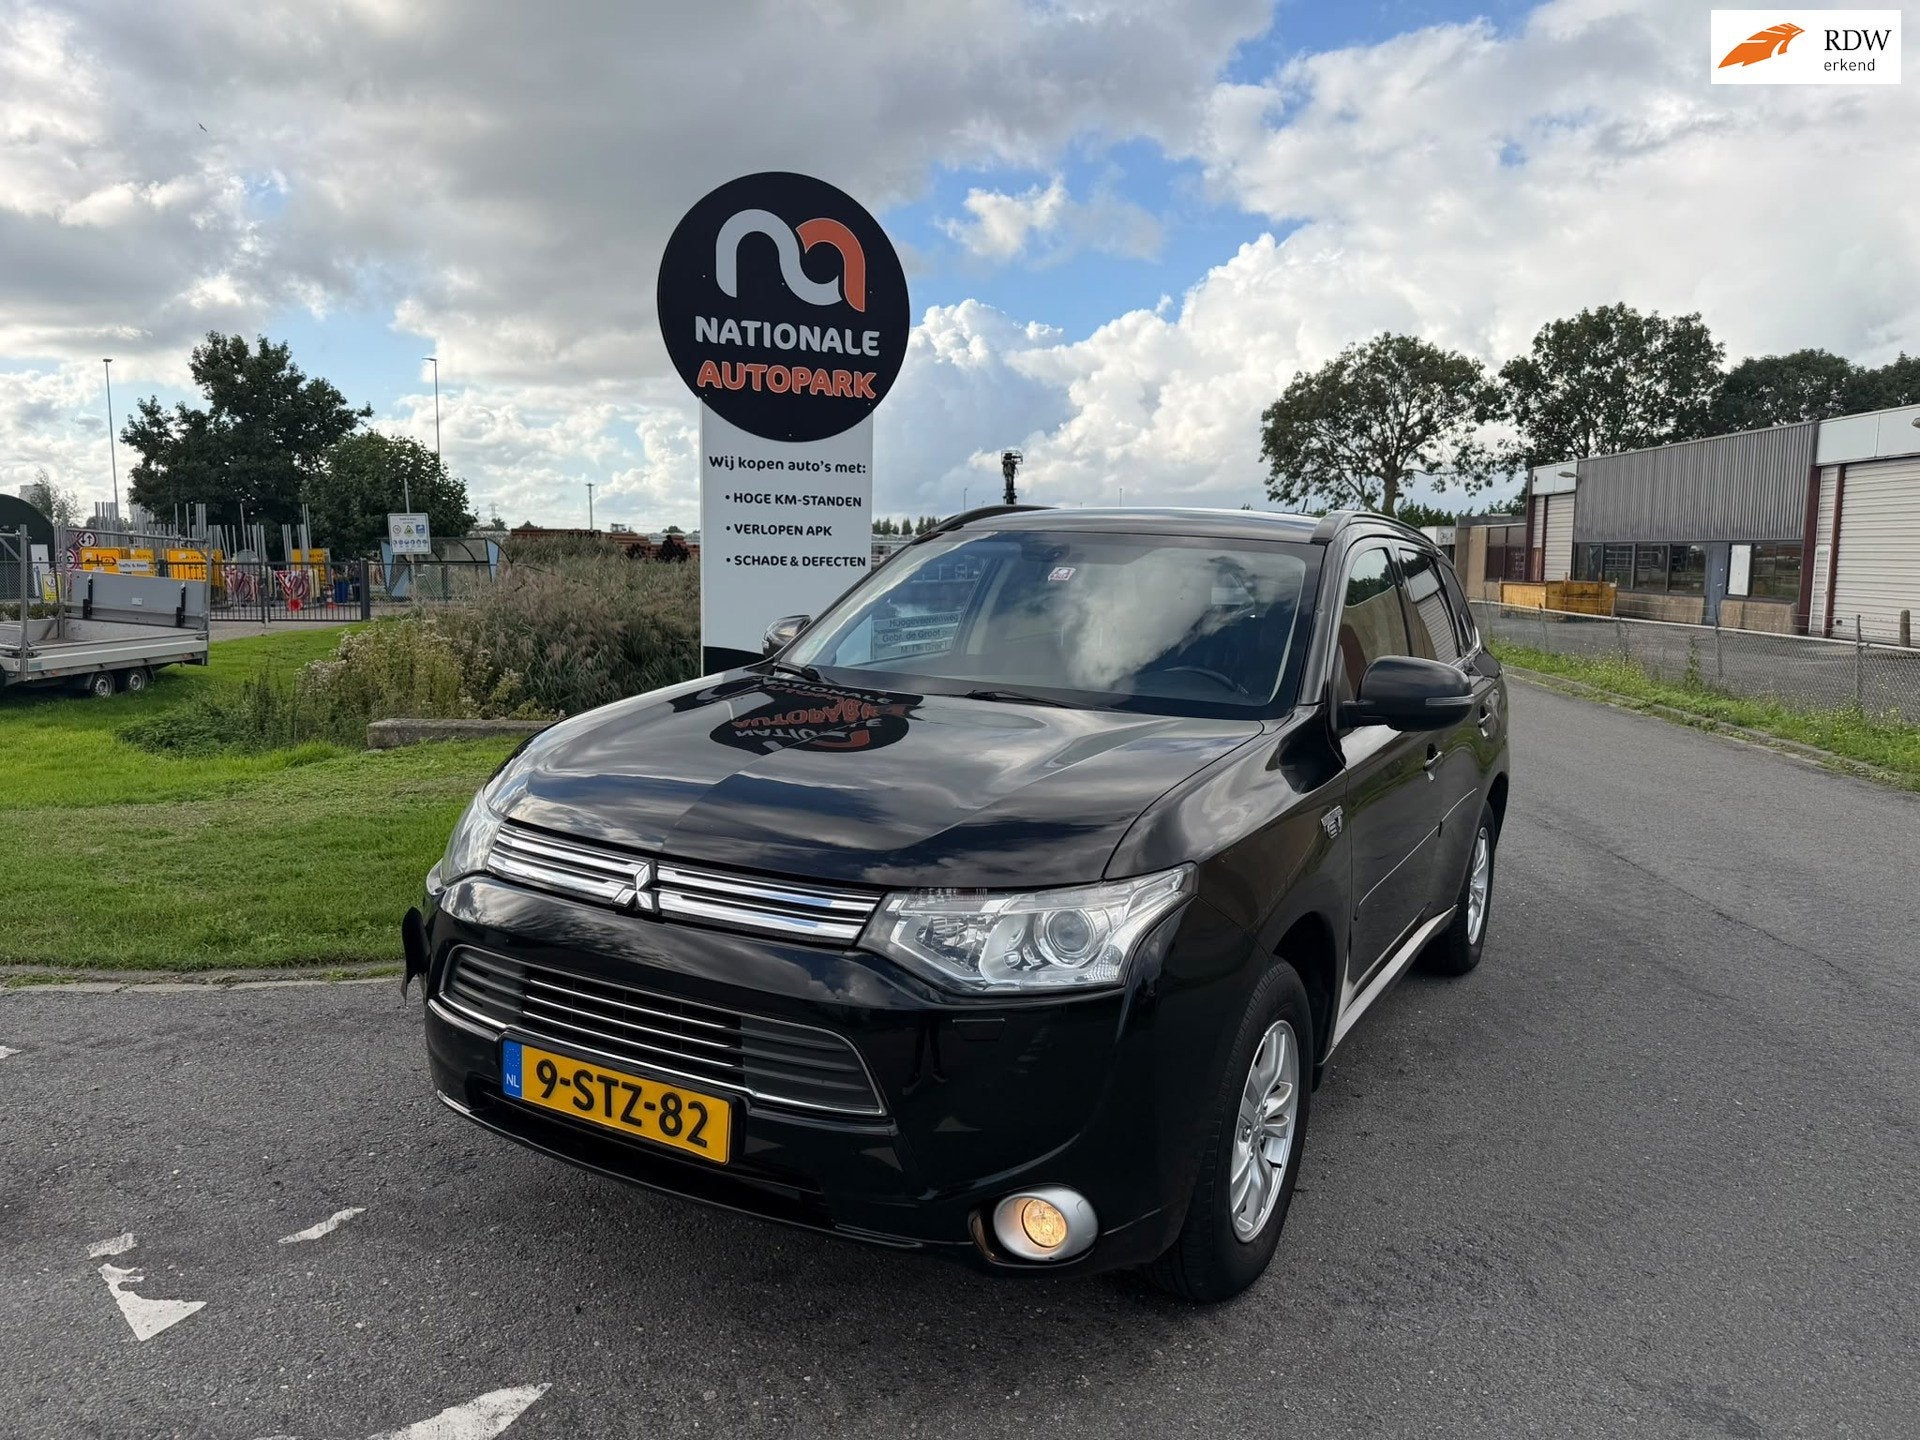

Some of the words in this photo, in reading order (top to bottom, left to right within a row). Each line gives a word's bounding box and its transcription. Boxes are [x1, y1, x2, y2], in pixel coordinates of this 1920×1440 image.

[695, 315, 880, 357] NATIONALE
[696, 360, 878, 400] AUTOPARK
[708, 455, 735, 471] Wij
[738, 456, 785, 472] kopen
[834, 462, 867, 474] met:
[733, 492, 772, 505] HOGE
[774, 493, 862, 508] KM-STANDEN
[733, 523, 804, 536] VERLOPEN
[805, 525, 833, 537] APK
[734, 555, 788, 567] SCHADE
[789, 556, 799, 568] &
[801, 556, 867, 568] DEFECTEN
[905, 631, 917, 640] de
[506, 1076, 520, 1088] NL
[536, 1058, 709, 1148] 9-STZ-82
